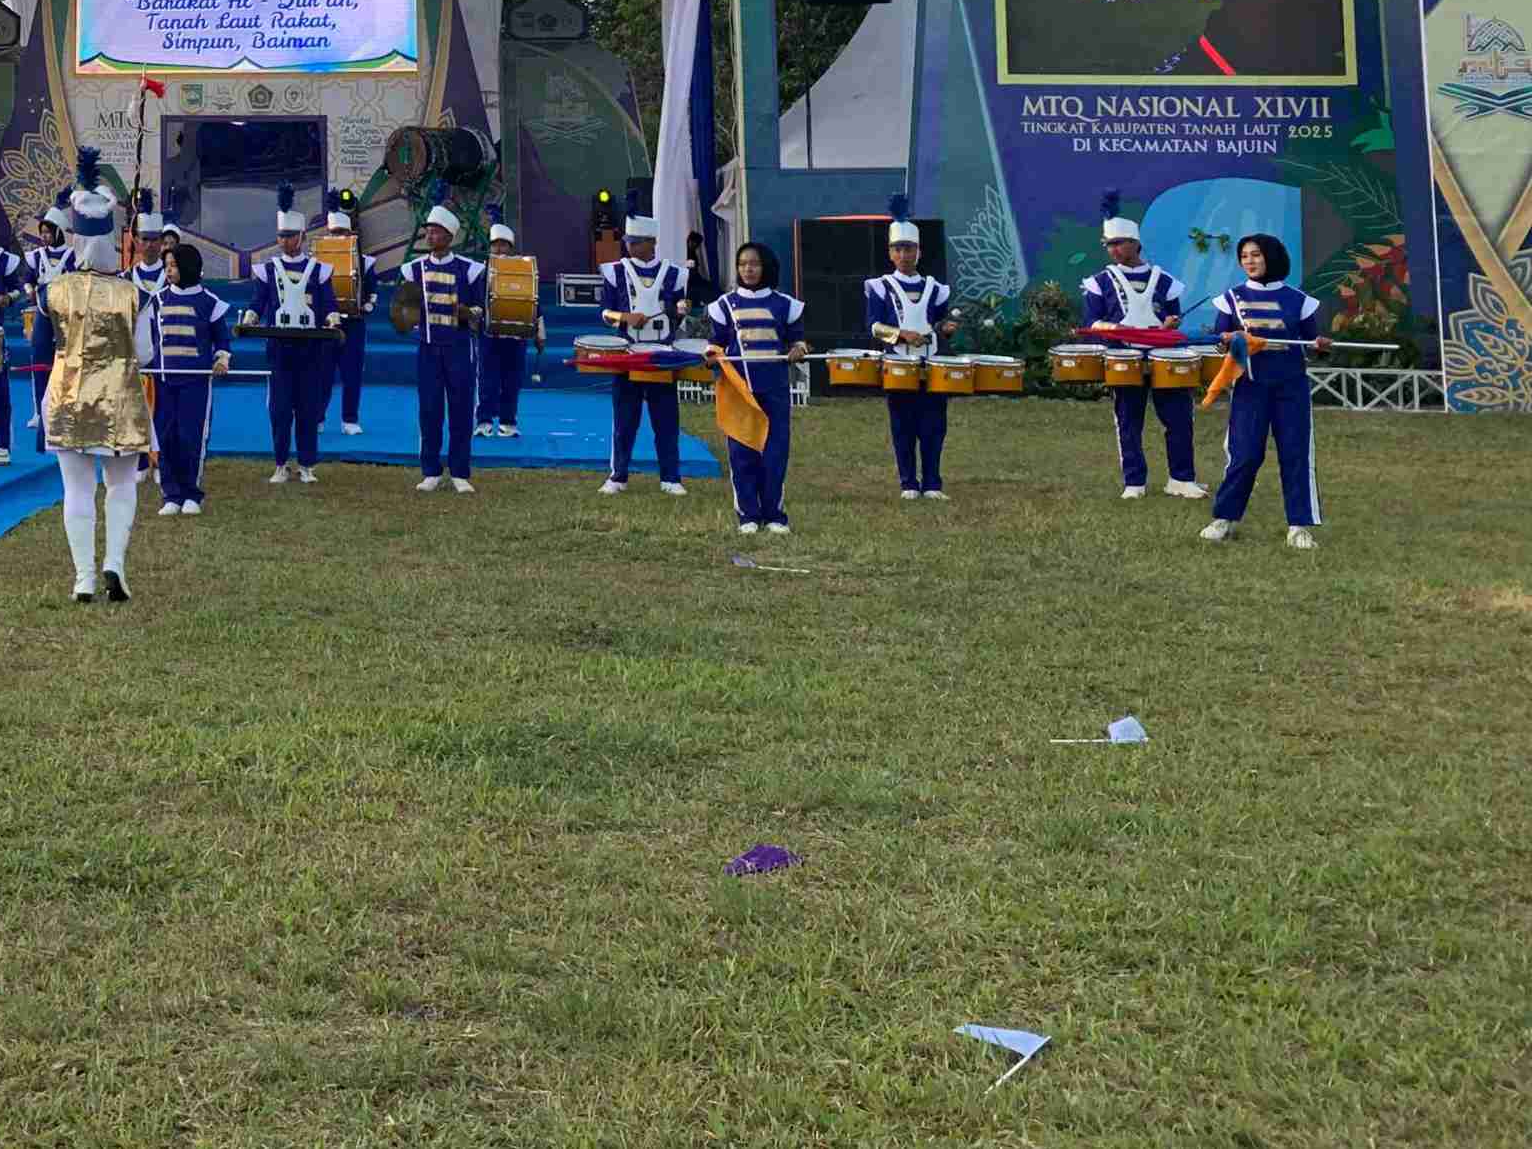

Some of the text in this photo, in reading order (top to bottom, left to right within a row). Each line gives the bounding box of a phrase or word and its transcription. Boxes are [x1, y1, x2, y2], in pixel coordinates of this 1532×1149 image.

[145, 11, 338, 31] Tanah Laut Rakat,
[162, 31, 332, 55] Simpun, Baiman
[1020, 95, 1332, 122] MTQ NASIONAL XLVII
[1020, 121, 1333, 139] TINGKAT KABUPATEN TANAH LAUT 2025
[1073, 138, 1277, 157] DI KECAMATAN BAJUIN
